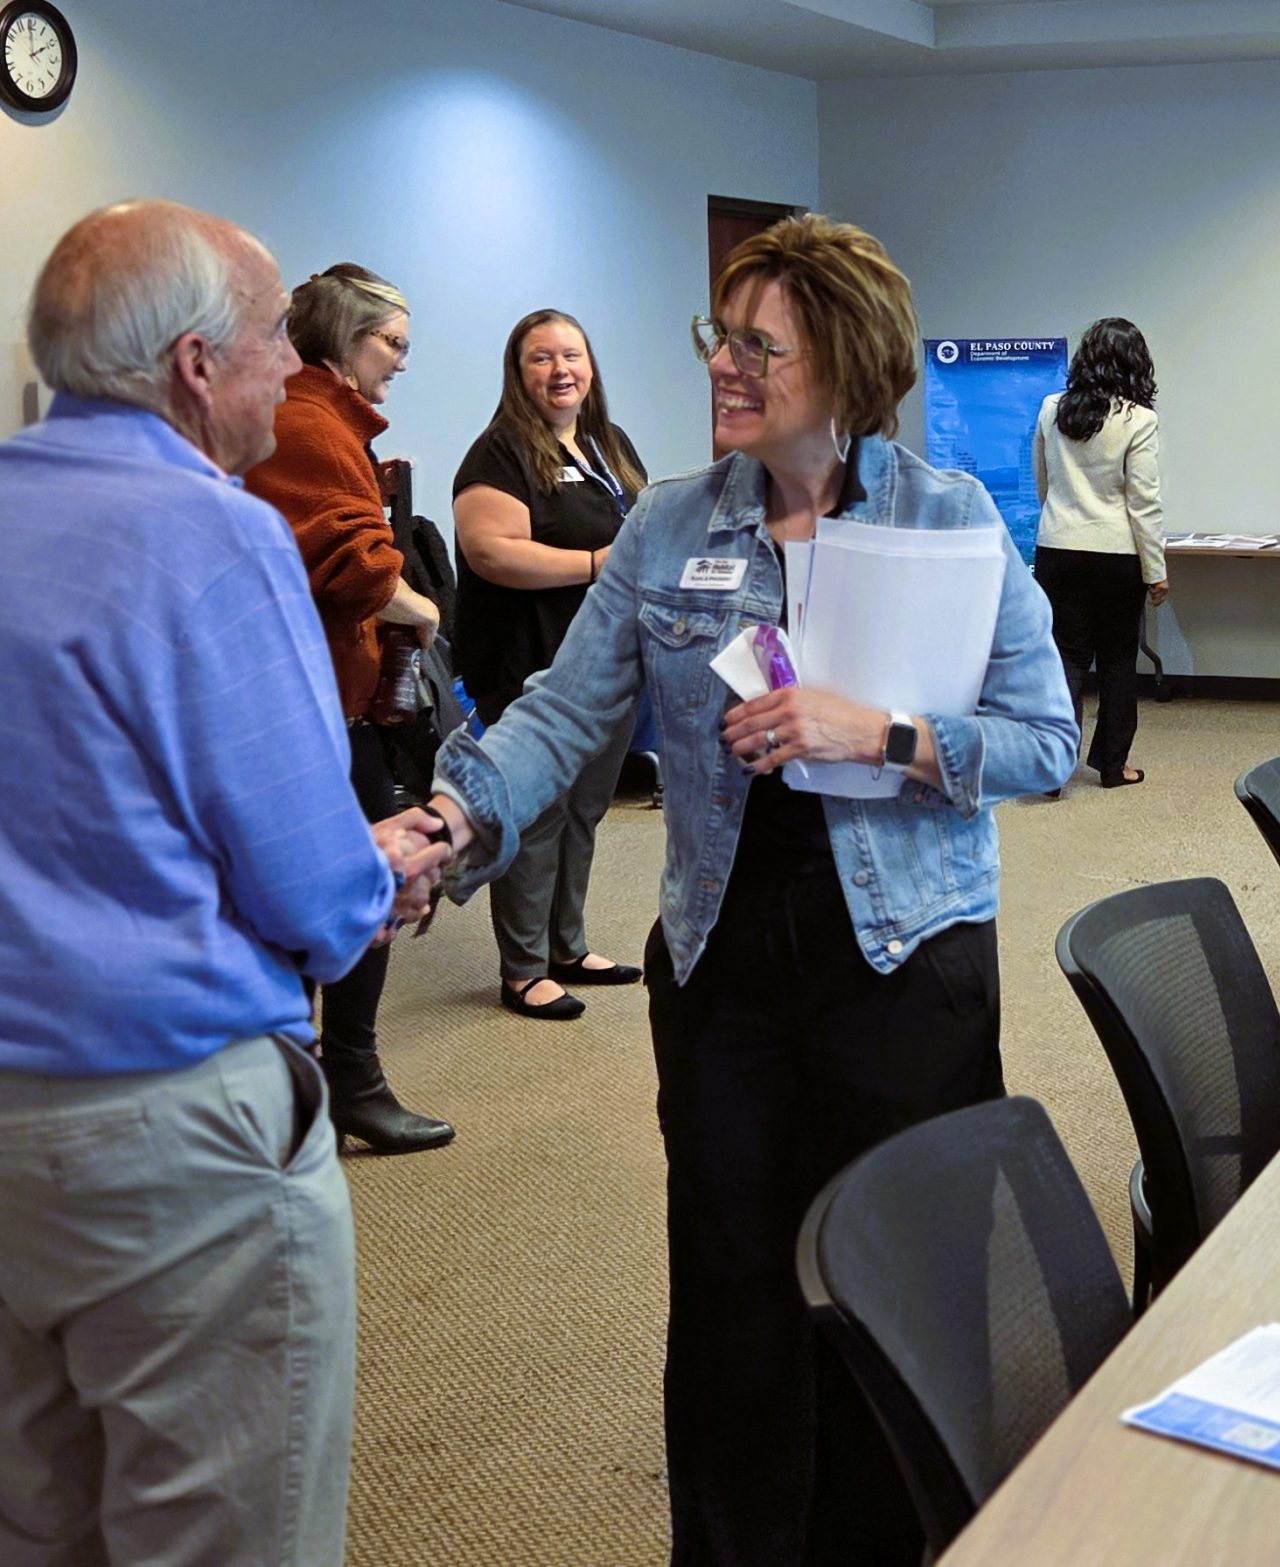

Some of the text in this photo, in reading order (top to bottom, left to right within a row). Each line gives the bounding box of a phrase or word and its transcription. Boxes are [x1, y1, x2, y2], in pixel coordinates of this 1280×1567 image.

[970, 341, 1055, 351] EL PASO COUNTY
